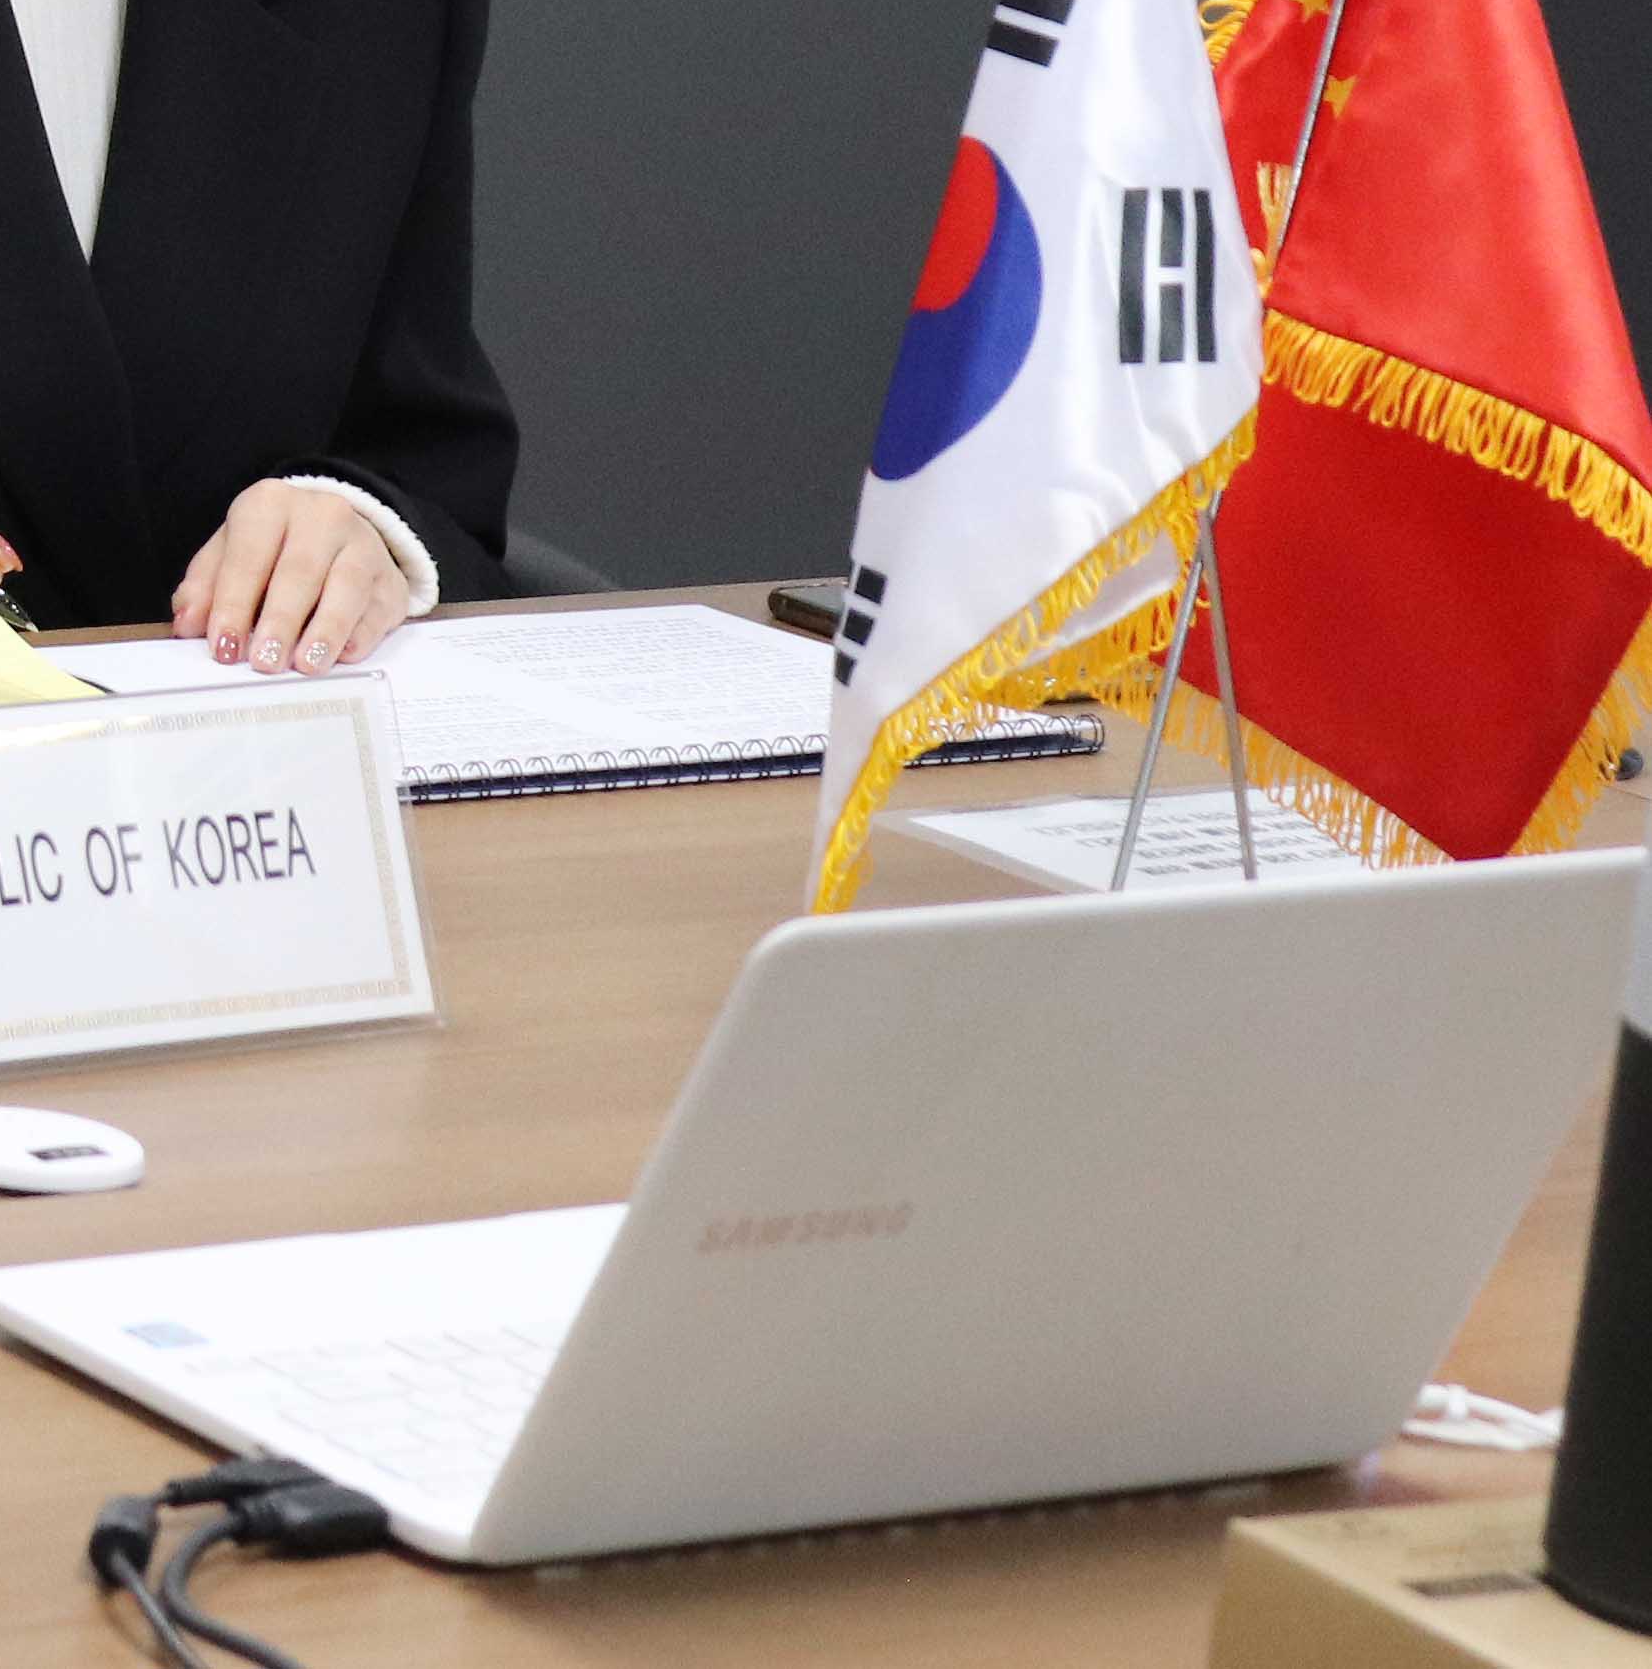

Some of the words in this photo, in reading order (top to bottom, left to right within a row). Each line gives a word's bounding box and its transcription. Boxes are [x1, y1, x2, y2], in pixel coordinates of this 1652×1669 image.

[85, 823, 143, 897] OF
[162, 807, 317, 889] KOREA
[697, 1200, 915, 1254] SAMSUNG
